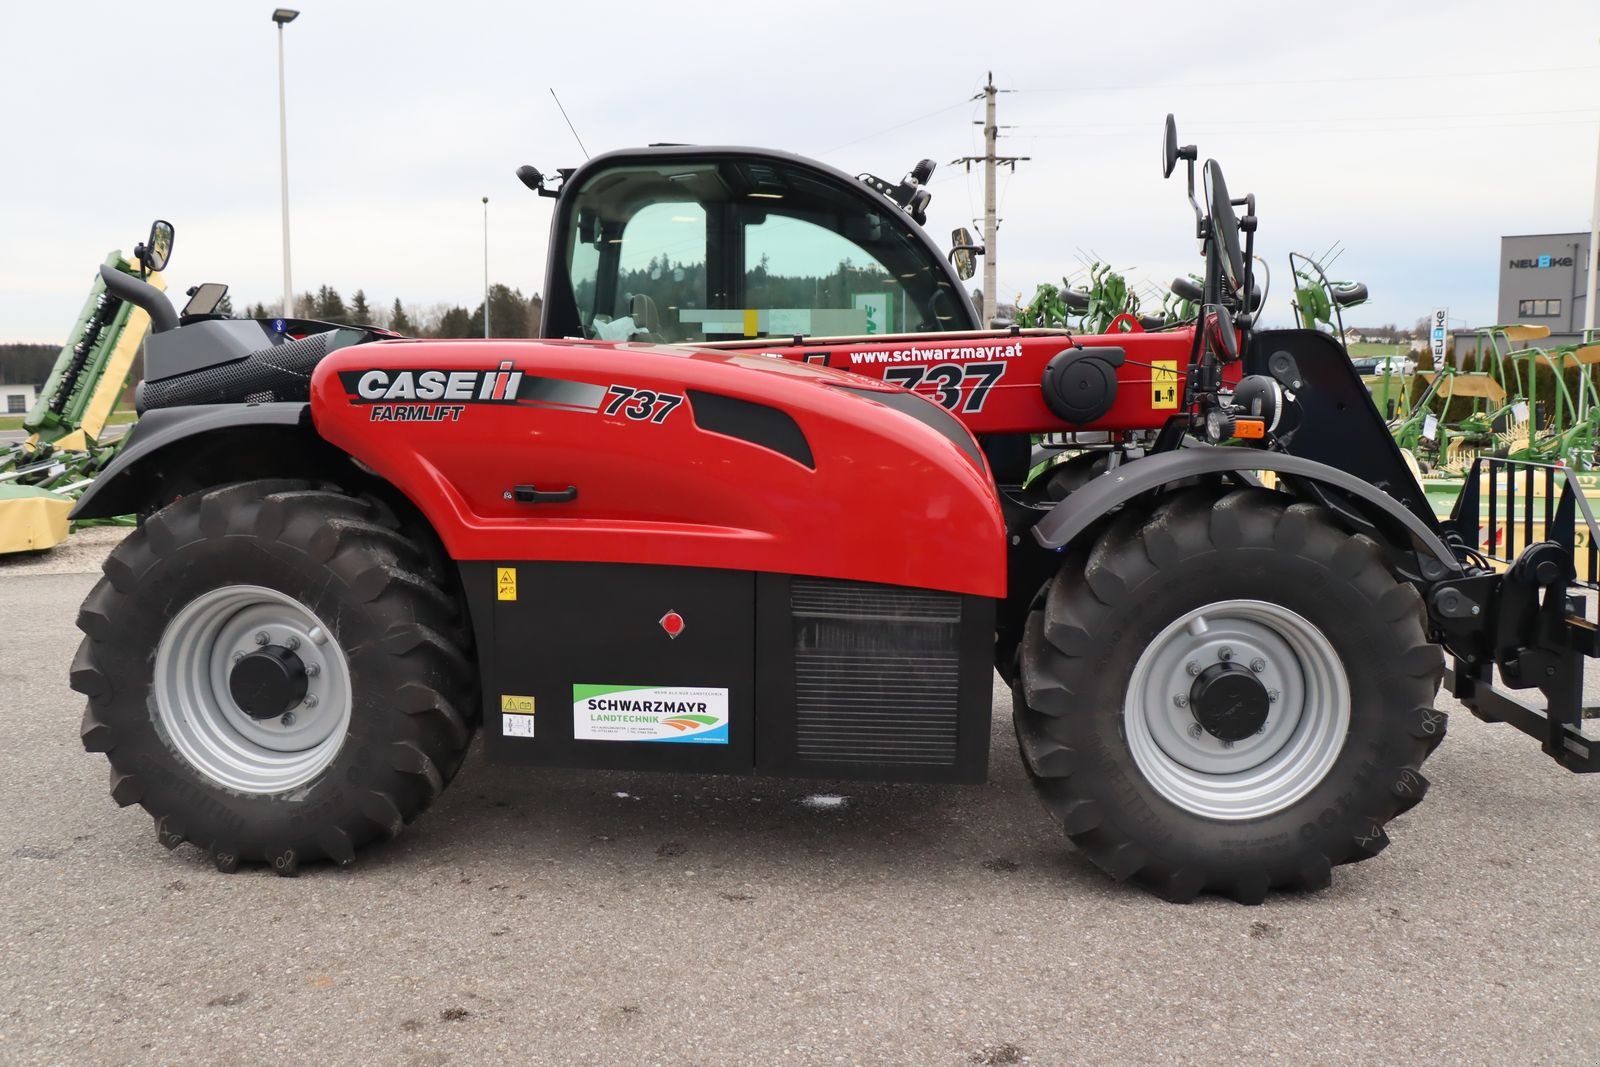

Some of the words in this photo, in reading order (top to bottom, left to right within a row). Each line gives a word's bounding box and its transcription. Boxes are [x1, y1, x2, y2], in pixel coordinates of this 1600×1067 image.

[850, 342, 1022, 364] www.schwarzmayr.at
[357, 370, 462, 400] CASE
[370, 405, 465, 421] FARMLIFT
[603, 384, 684, 424] 737
[588, 699, 707, 713] SCHWARZMAYR
[590, 714, 660, 724] LANDTECHNIK
